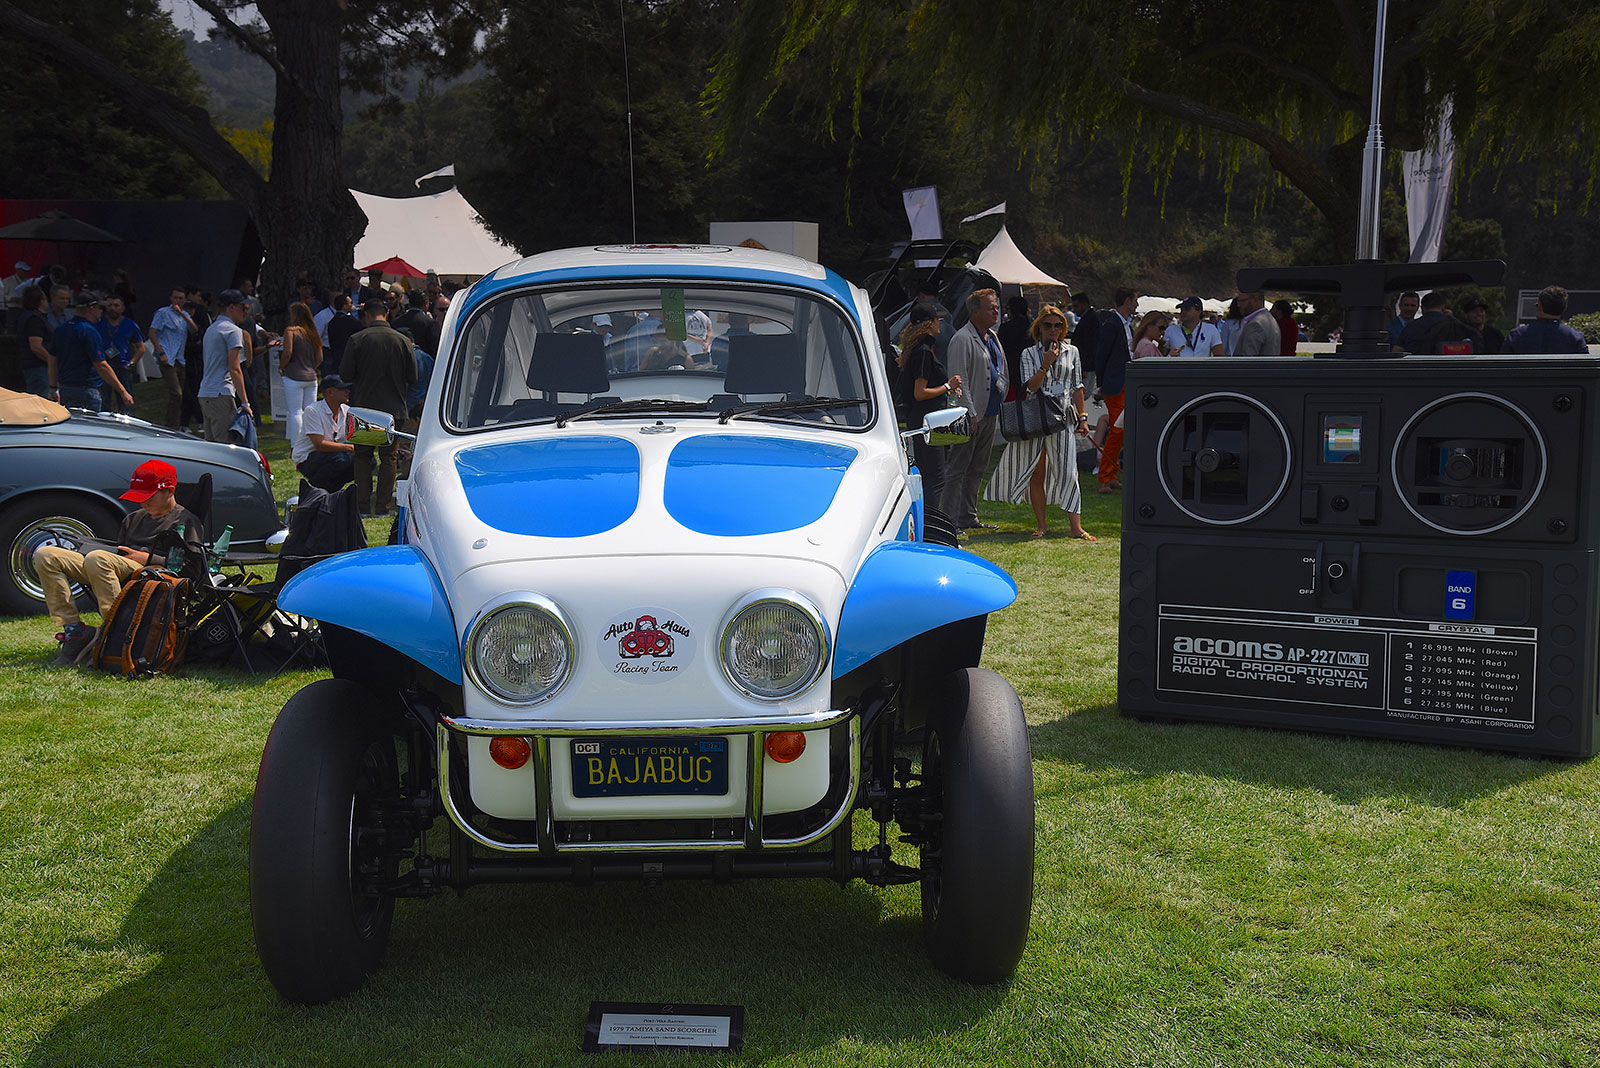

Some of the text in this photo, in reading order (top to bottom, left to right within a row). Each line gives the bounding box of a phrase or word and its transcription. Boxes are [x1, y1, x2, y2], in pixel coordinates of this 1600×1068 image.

[1448, 585, 1472, 593] BAND
[1452, 598, 1466, 610] 6
[1318, 617, 1355, 625] POWER
[603, 620, 690, 641] Auto Haus
[1438, 625, 1486, 634] CRYSTAL
[1172, 635, 1284, 661] acoms
[1287, 647, 1337, 664] AP-227
[1457, 646, 1476, 654] MHz
[1481, 647, 1518, 657] (Brown)
[613, 660, 678, 675] Racing Team
[1172, 656, 1369, 680] DIGITAL PROPORTIONAL
[1456, 657, 1476, 665] MHz
[1481, 659, 1507, 668] (Red)
[1172, 664, 1368, 689] RADIO CONTROL SYSTEM
[1404, 664, 1413, 672] 3
[1456, 669, 1476, 677] MHz
[1481, 670, 1520, 680] (Orange)
[1404, 675, 1413, 683] 4
[1456, 680, 1475, 688] MHz
[1480, 682, 1519, 692] (Yellow)
[1455, 692, 1475, 700] MHz
[1480, 693, 1514, 703] (Green)
[1455, 703, 1474, 711] MHz
[1479, 705, 1508, 714] (Blue)
[1386, 711, 1441, 722] MANUFACTURED
[1460, 718, 1482, 726] ASAHI
[1484, 720, 1535, 730] CORPORATION
[577, 744, 598, 753] OCT
[609, 747, 690, 756] CALIFORNIA
[587, 756, 712, 785] BAJABUG
